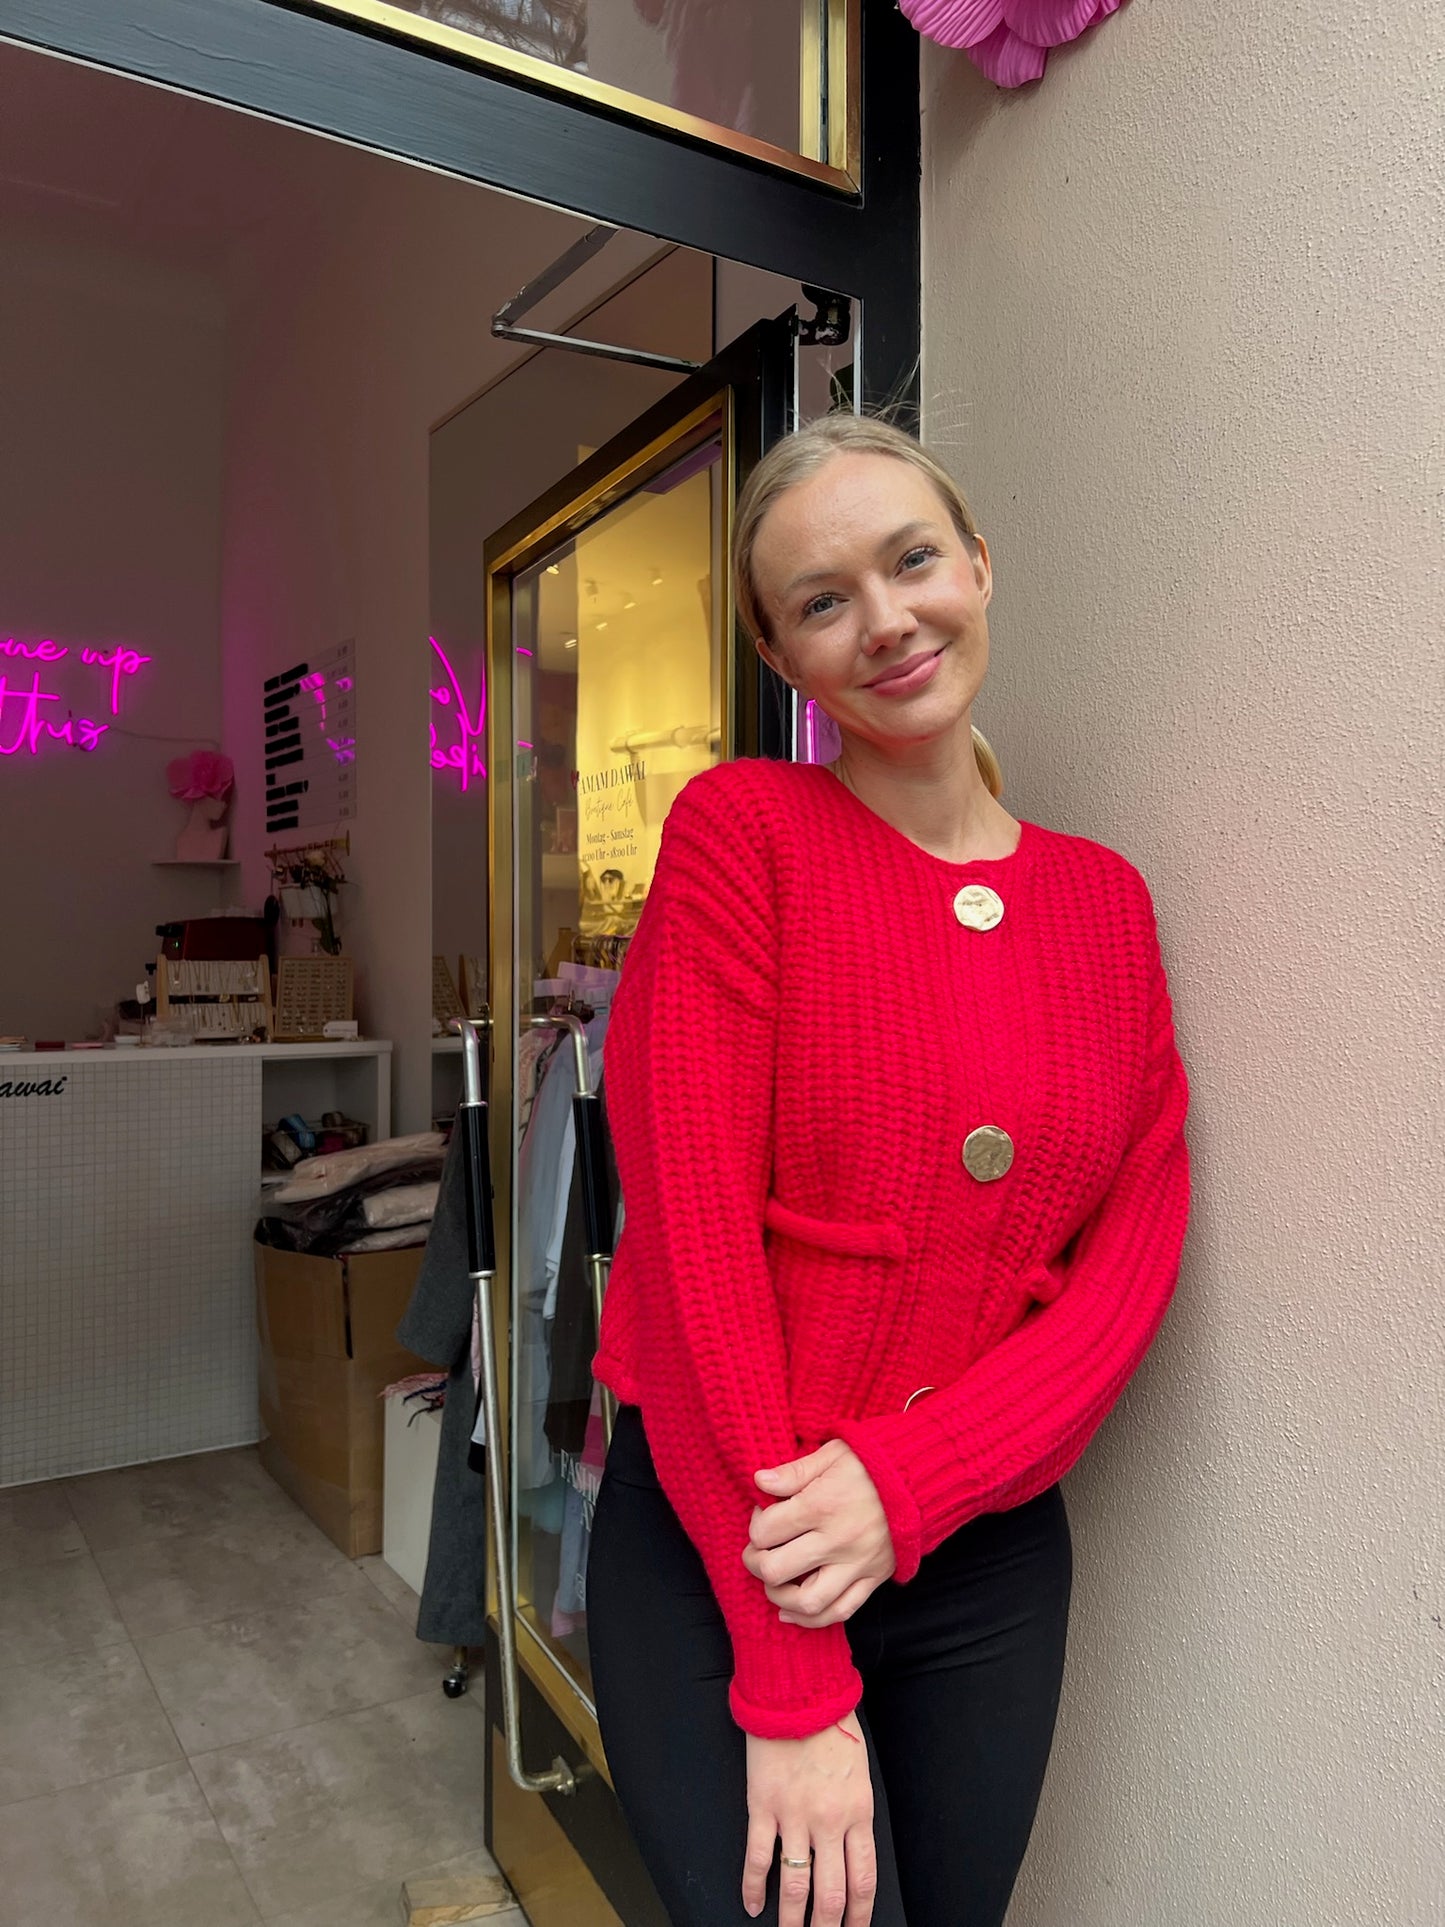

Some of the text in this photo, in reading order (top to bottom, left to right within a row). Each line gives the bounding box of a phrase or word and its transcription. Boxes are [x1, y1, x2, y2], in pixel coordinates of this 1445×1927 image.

[82, 646, 151, 716] up
[586, 832, 606, 845] Montag
[610, 827, 634, 842] Samstag
[595, 848, 606, 861] Uhr
[626, 843, 637, 857] Uhr
